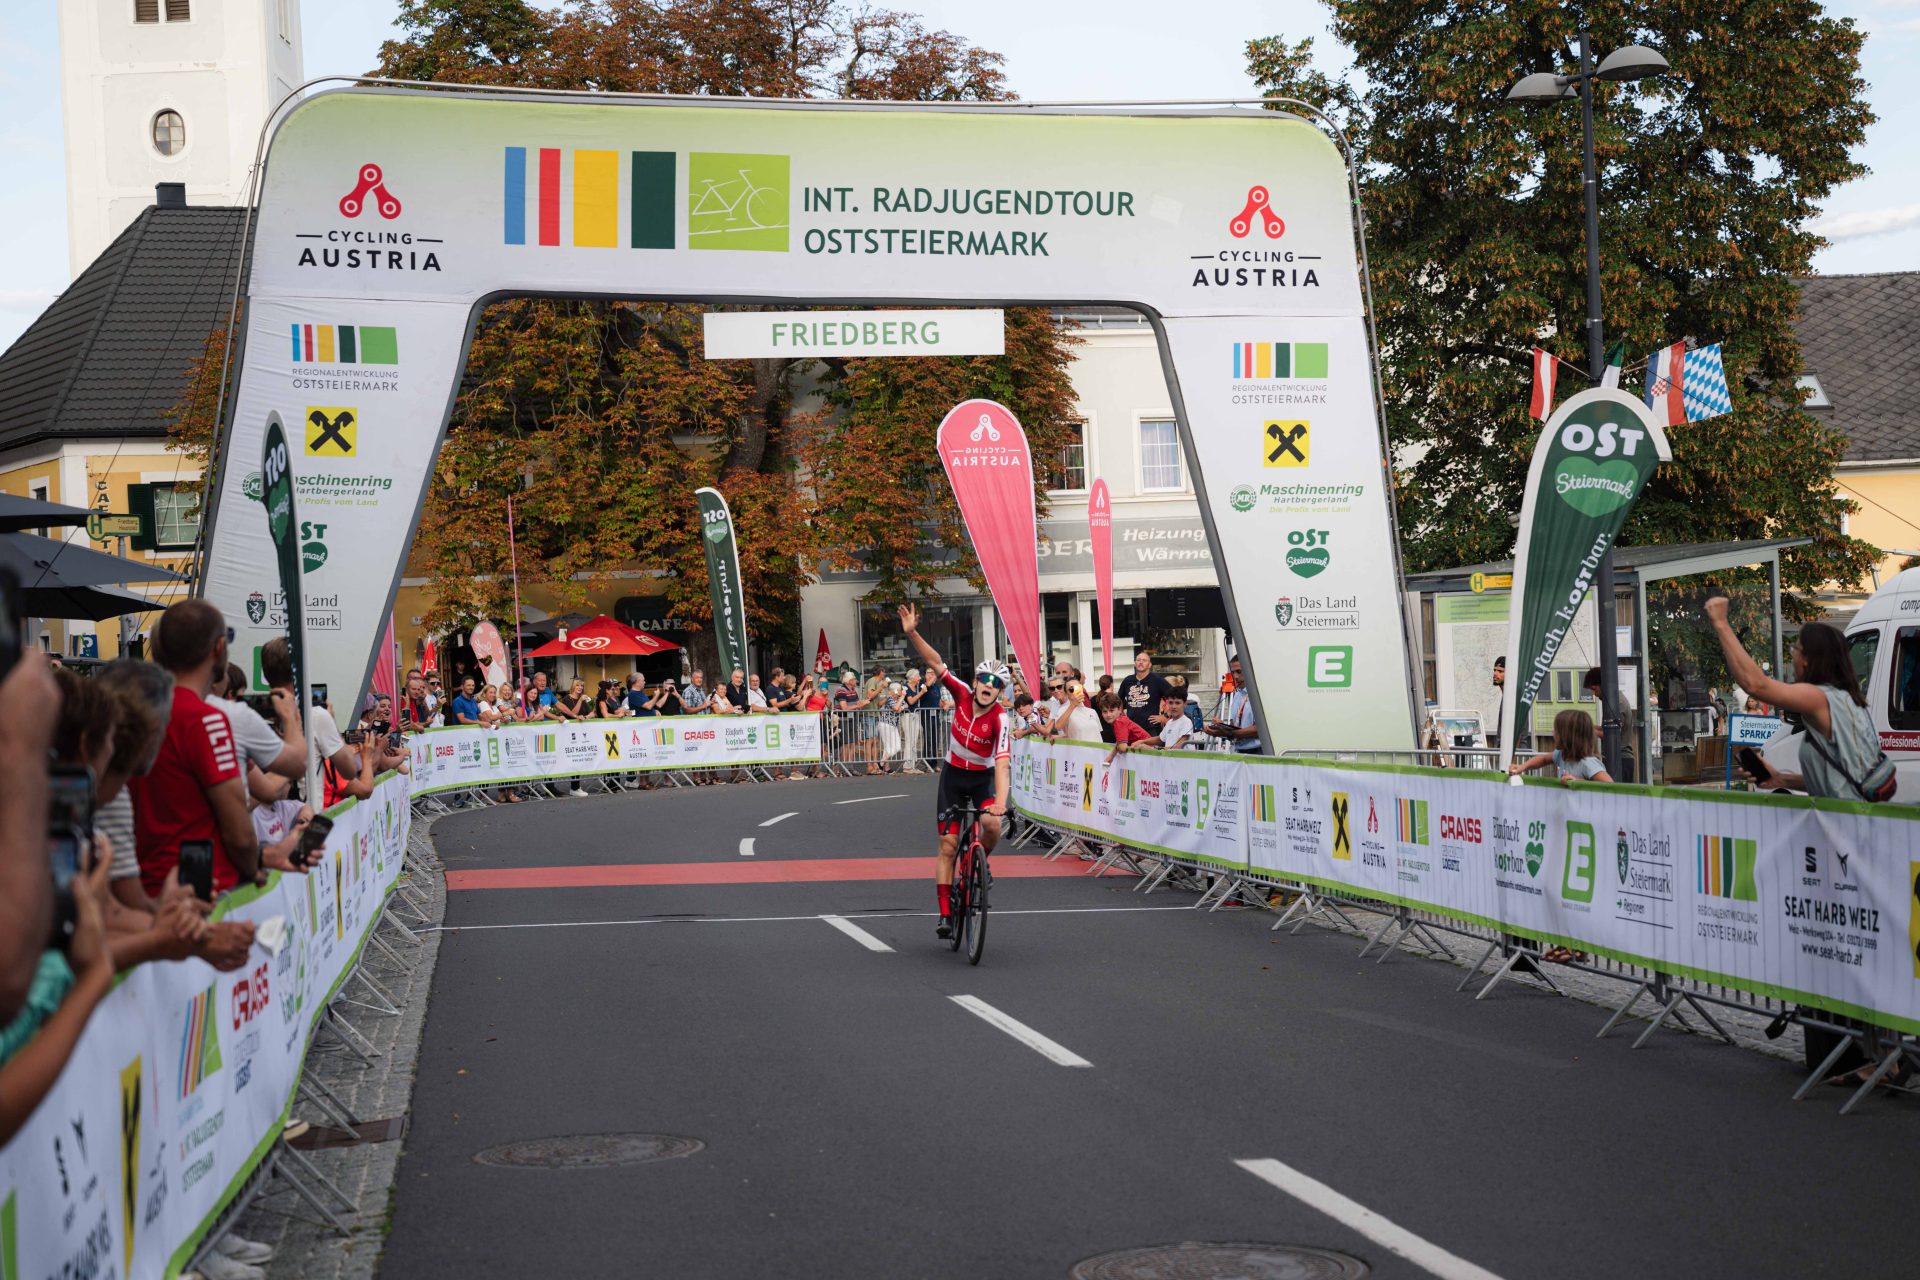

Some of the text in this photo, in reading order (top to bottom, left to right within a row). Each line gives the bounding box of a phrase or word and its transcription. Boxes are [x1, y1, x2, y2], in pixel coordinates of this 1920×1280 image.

[803, 187, 1136, 217] INT. RADJUGENDTOUR
[328, 230, 413, 245] CYCLING
[803, 228, 1049, 257] OSTSTEIERMARK
[298, 247, 442, 272] AUSTRIA
[1219, 250, 1295, 263] CYCLING
[1192, 268, 1320, 288] AUSTRIA
[771, 321, 941, 348] FRIEDBERG
[292, 368, 399, 380] REGIONALENTWICKLUNG
[292, 379, 399, 392] OSTSTEIERMARK
[1232, 384, 1327, 392] REGIONALENTWICKLUNG
[1232, 395, 1327, 405] OSTSTEIERMARK
[1561, 422, 1644, 456] OST
[295, 475, 393, 490] schinenring
[1260, 484, 1364, 497] Maschinenring
[1556, 472, 1634, 501] Steiermark
[1273, 496, 1348, 505] Hartbergerland
[299, 521, 328, 541] ST
[1122, 527, 1206, 541] Heizung
[1287, 529, 1330, 547] OST
[1135, 547, 1214, 562] Wärme
[1286, 556, 1328, 568] Steiermark
[304, 594, 338, 607] Land
[1299, 596, 1356, 609] Das Land
[1296, 614, 1357, 627] Steiermark
[1520, 627, 1567, 707] Einfach
[684, 730, 715, 741] CRAISS
[954, 717, 991, 745] AUSTRIA
[1440, 814, 1482, 844] CRAISS
[1528, 820, 1546, 841] OST
[1632, 830, 1670, 857] Das Land
[1362, 853, 1387, 869] AUSTRIA
[1630, 867, 1671, 894] Steiermark
[1784, 895, 1880, 933] SEAT HARB WEIZ
[1697, 922, 1759, 947] OSTSTEIERMARK
